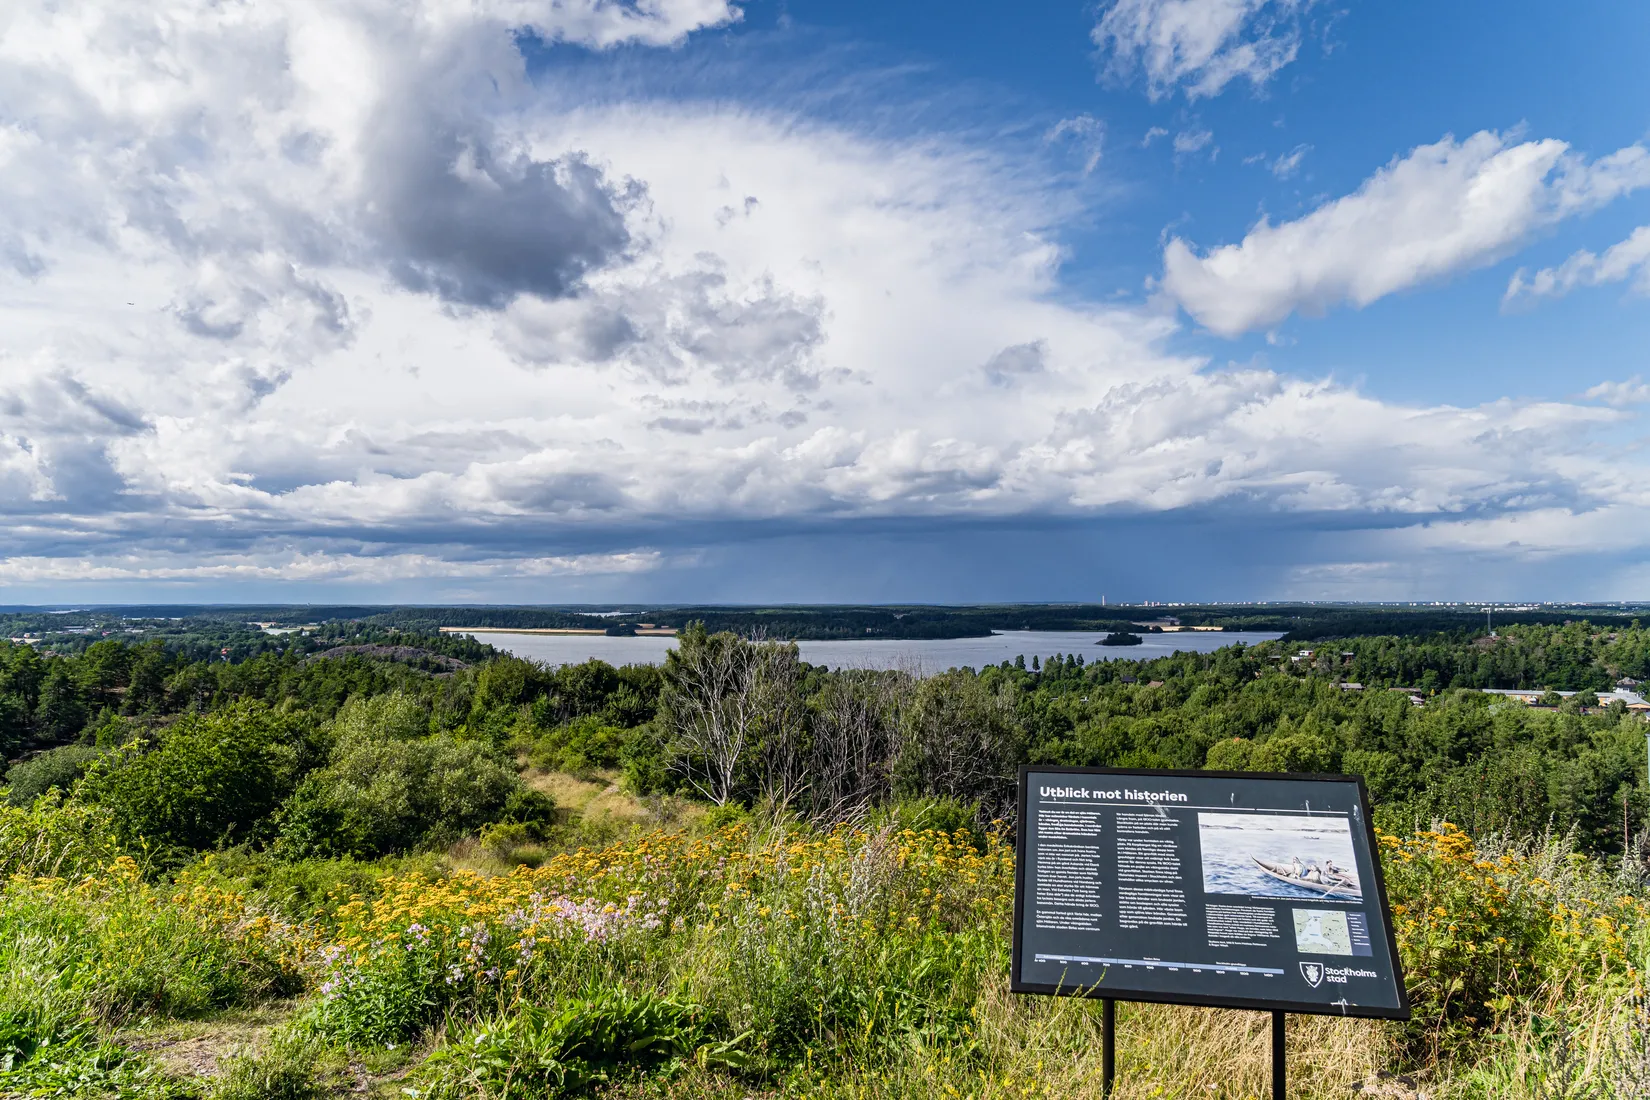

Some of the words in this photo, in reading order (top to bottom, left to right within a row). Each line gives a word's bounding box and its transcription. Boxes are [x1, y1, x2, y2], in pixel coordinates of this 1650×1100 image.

[1040, 786, 1090, 799] Utblick
[1093, 789, 1121, 799] mot
[1124, 789, 1188, 802] historien
[1325, 967, 1377, 978] Stockholms
[1326, 975, 1347, 984] stad
